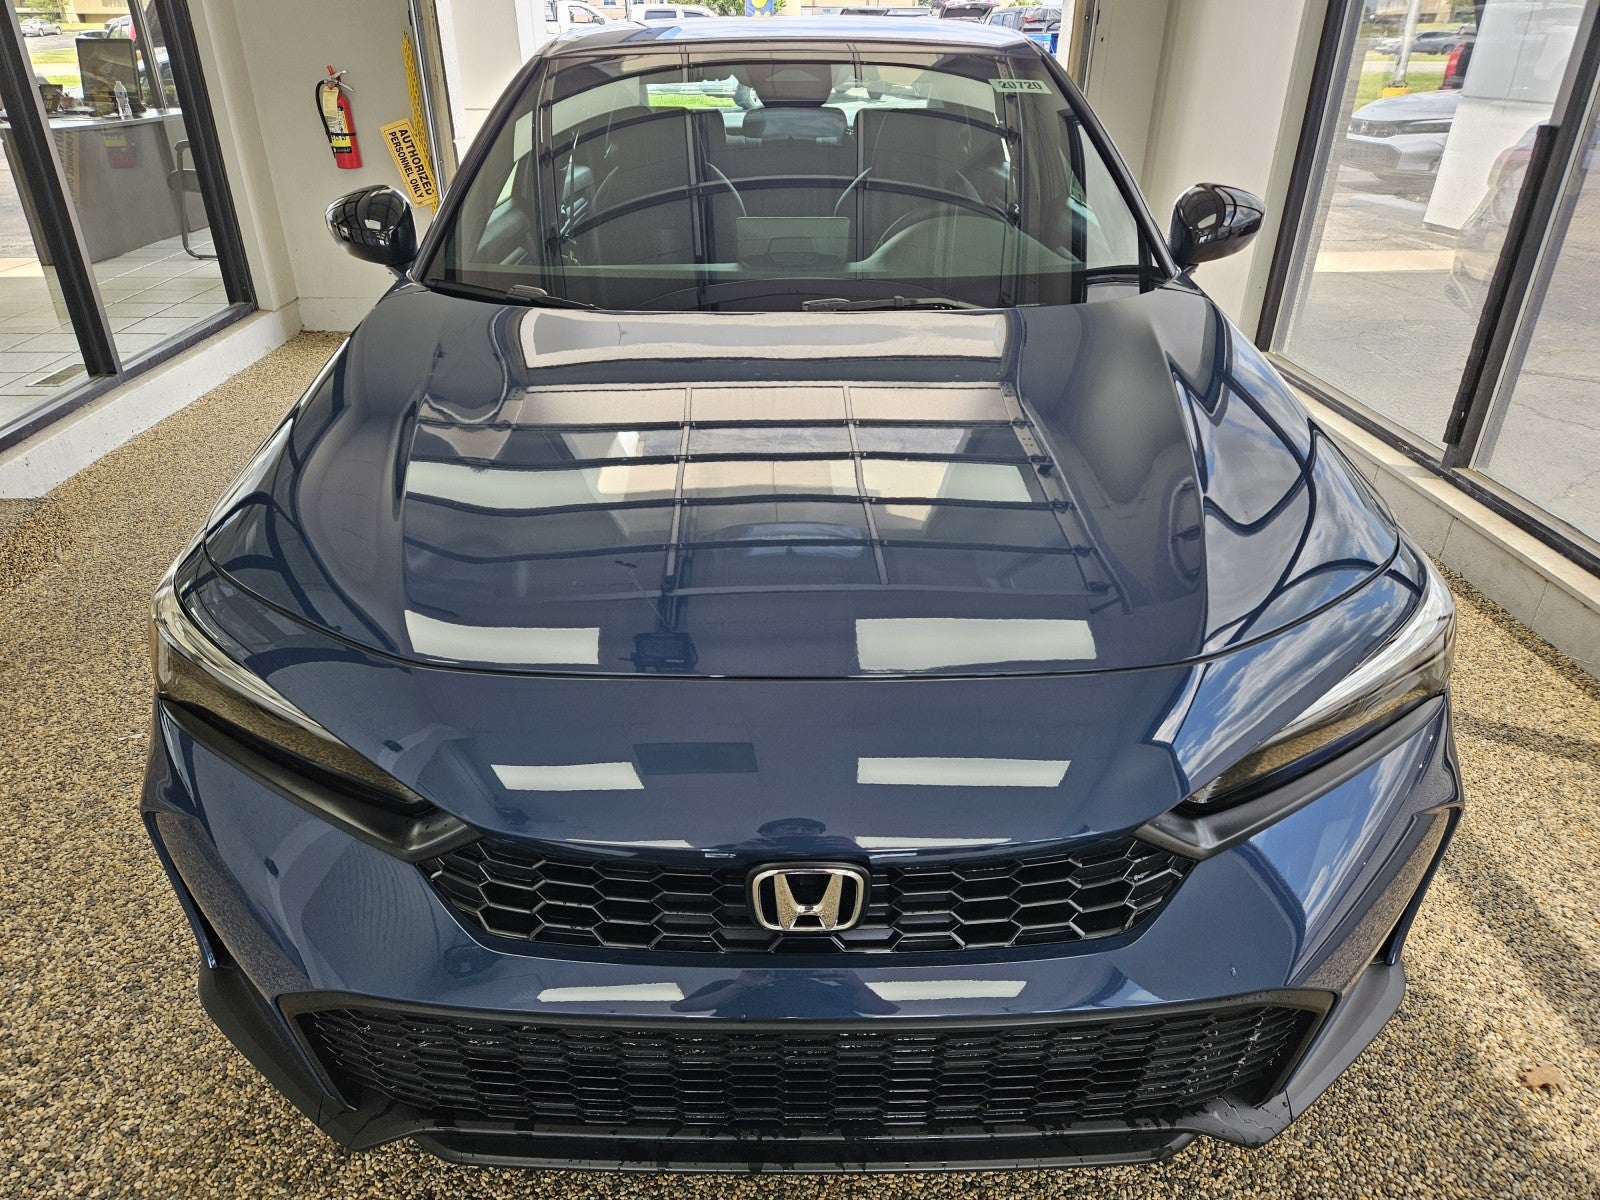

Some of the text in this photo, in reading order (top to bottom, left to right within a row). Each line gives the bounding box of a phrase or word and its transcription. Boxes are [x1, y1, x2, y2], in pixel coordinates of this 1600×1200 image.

[998, 81, 1043, 90] 20720
[388, 131, 425, 199] PERSONNEL ONLY
[398, 128, 433, 196] AUTHORIZED
